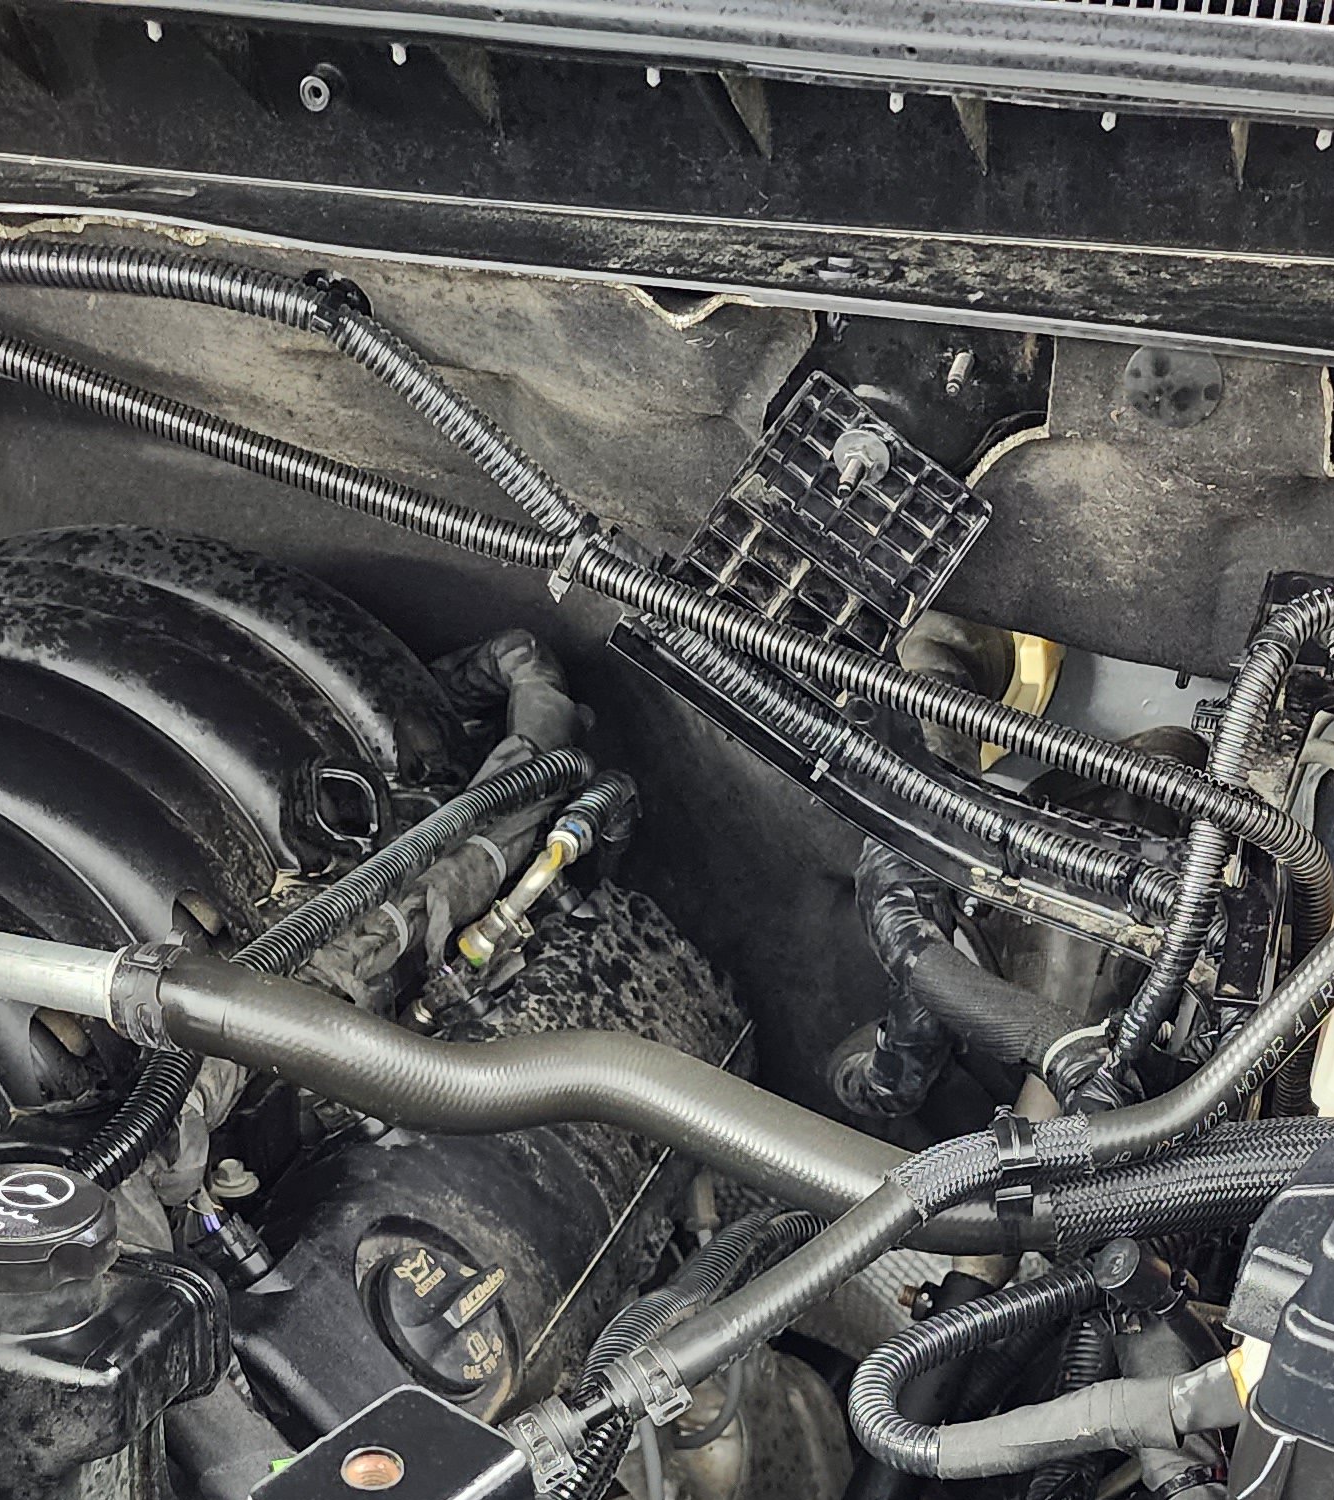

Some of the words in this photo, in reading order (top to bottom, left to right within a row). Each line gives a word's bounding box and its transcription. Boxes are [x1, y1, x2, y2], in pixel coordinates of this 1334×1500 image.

[1233, 1035, 1288, 1102] MOTOR
[1293, 1015, 1306, 1037] 4
[458, 1267, 505, 1317] ACDelco
